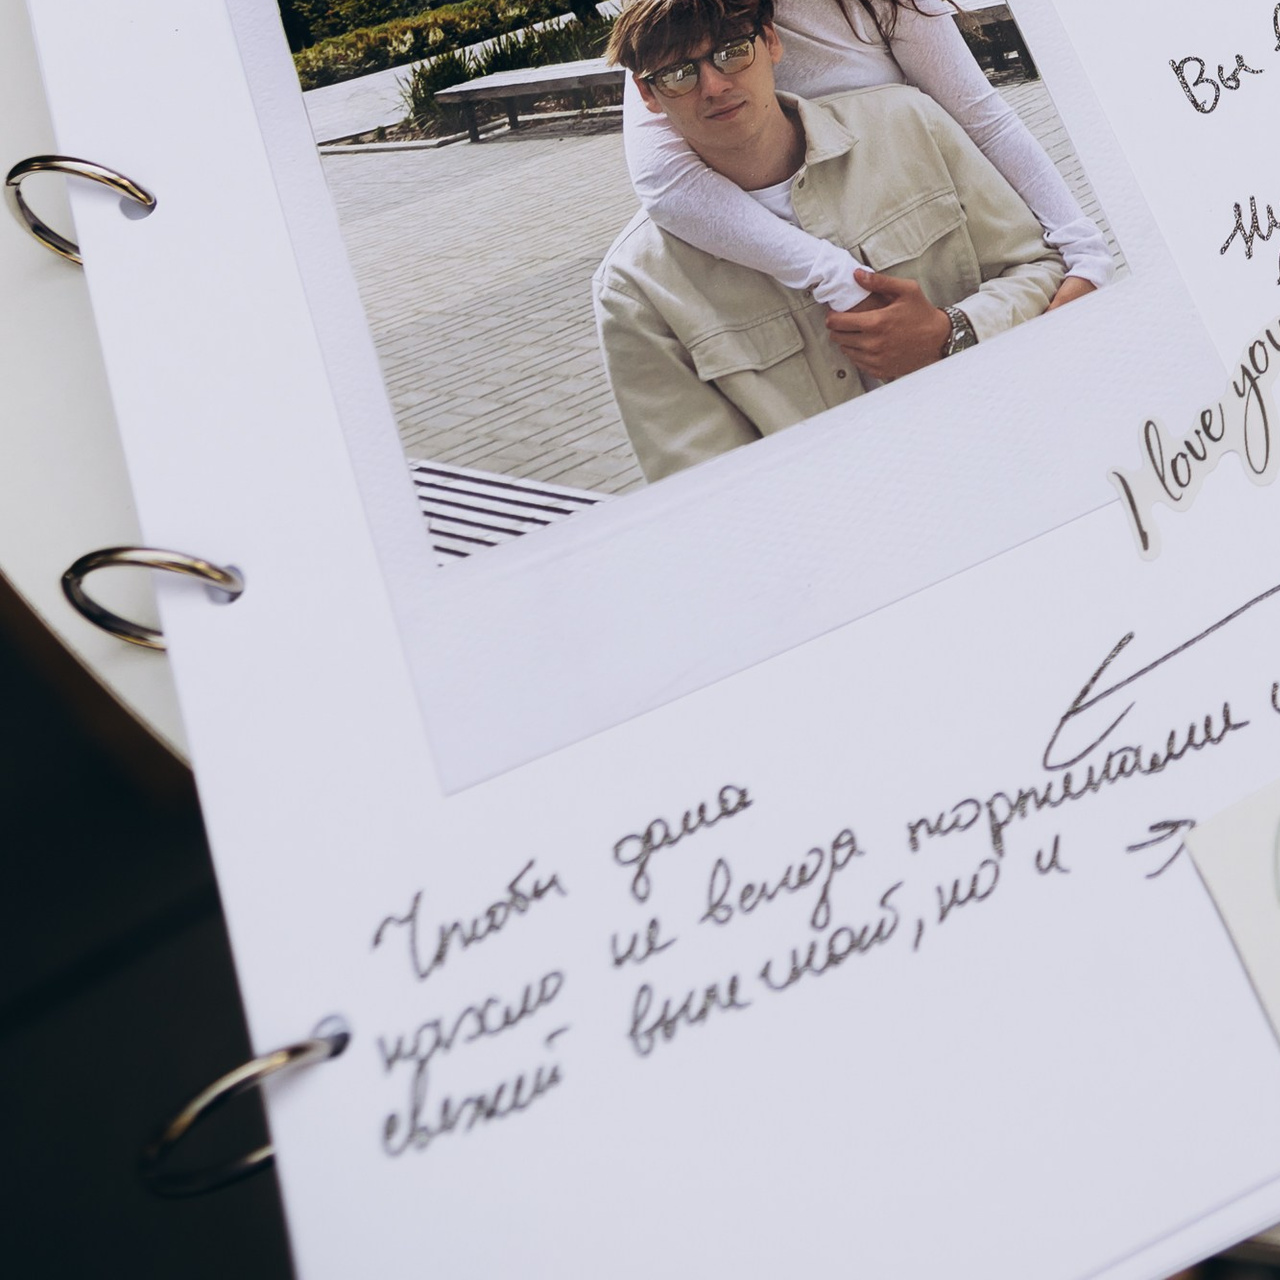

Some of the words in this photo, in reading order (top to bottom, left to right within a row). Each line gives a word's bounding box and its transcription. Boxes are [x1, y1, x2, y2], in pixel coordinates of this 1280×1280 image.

[1169, 50, 1266, 115] Вы
[1142, 399, 1226, 499] love
[369, 858, 571, 984] Чтобы
[611, 782, 757, 904] дома
[377, 969, 571, 1076] пахло
[610, 921, 680, 972] не
[697, 827, 867, 932] всегда
[378, 1025, 573, 1162] свежей
[935, 858, 1004, 918] но
[1033, 834, 1071, 878] и
